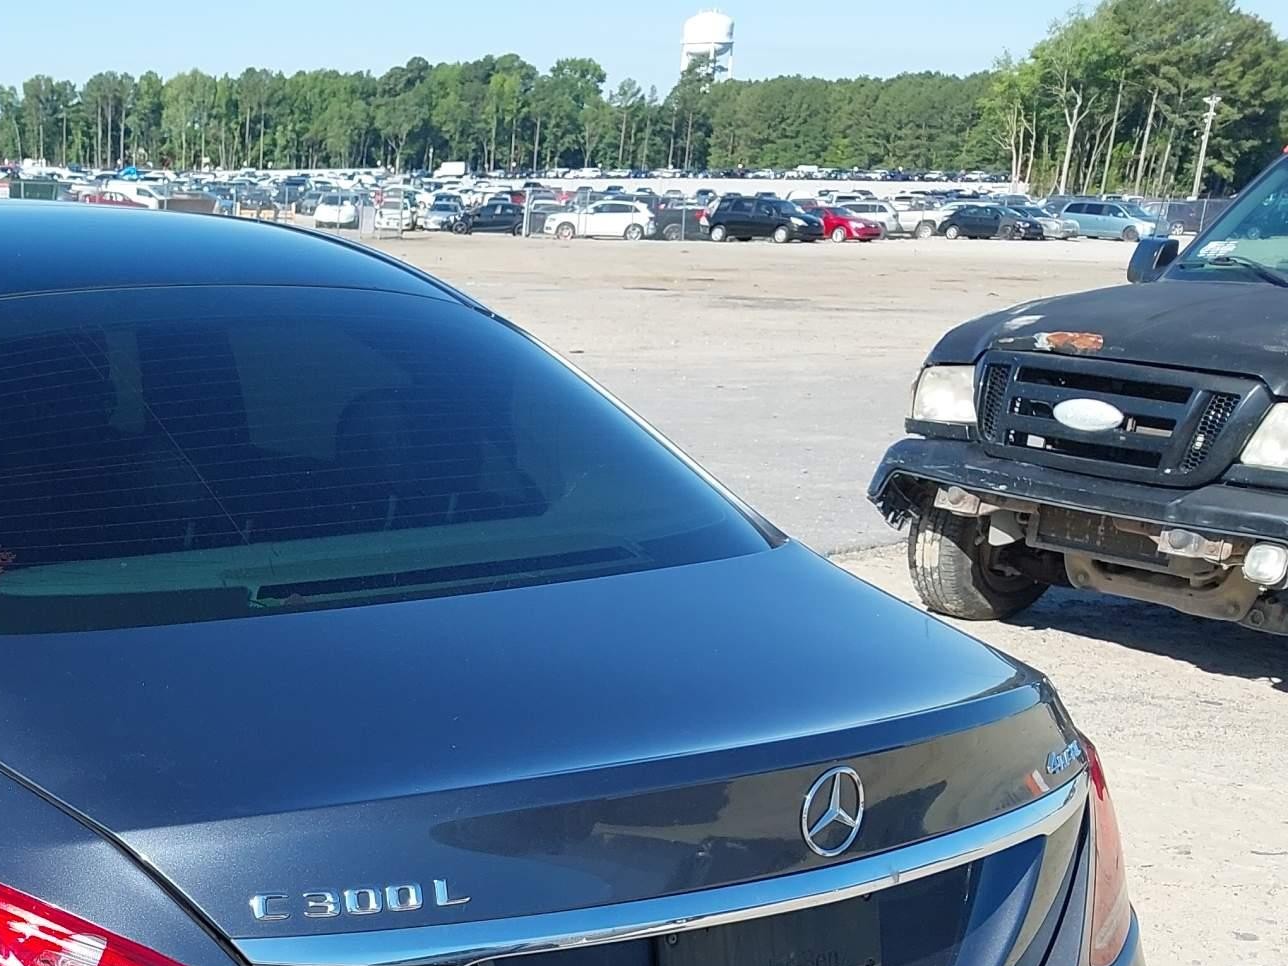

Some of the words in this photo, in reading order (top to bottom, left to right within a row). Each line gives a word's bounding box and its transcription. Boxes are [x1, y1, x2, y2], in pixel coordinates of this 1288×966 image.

[250, 891, 291, 922] C
[302, 883, 424, 919] 300
[433, 878, 472, 907] L
